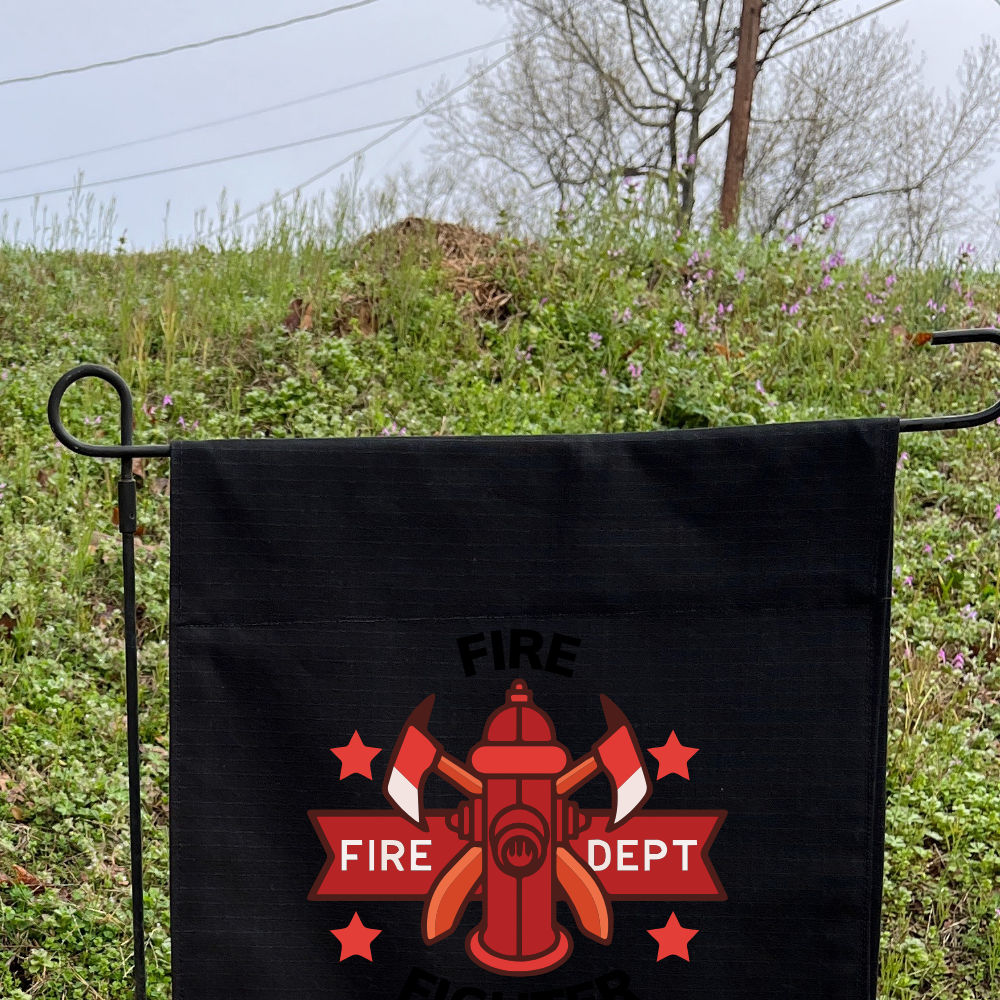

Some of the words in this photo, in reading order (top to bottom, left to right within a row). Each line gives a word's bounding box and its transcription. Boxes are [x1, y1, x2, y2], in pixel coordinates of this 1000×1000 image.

[456, 628, 581, 677] FIRE
[340, 839, 433, 873] FIRE
[587, 839, 698, 873] DEPT
